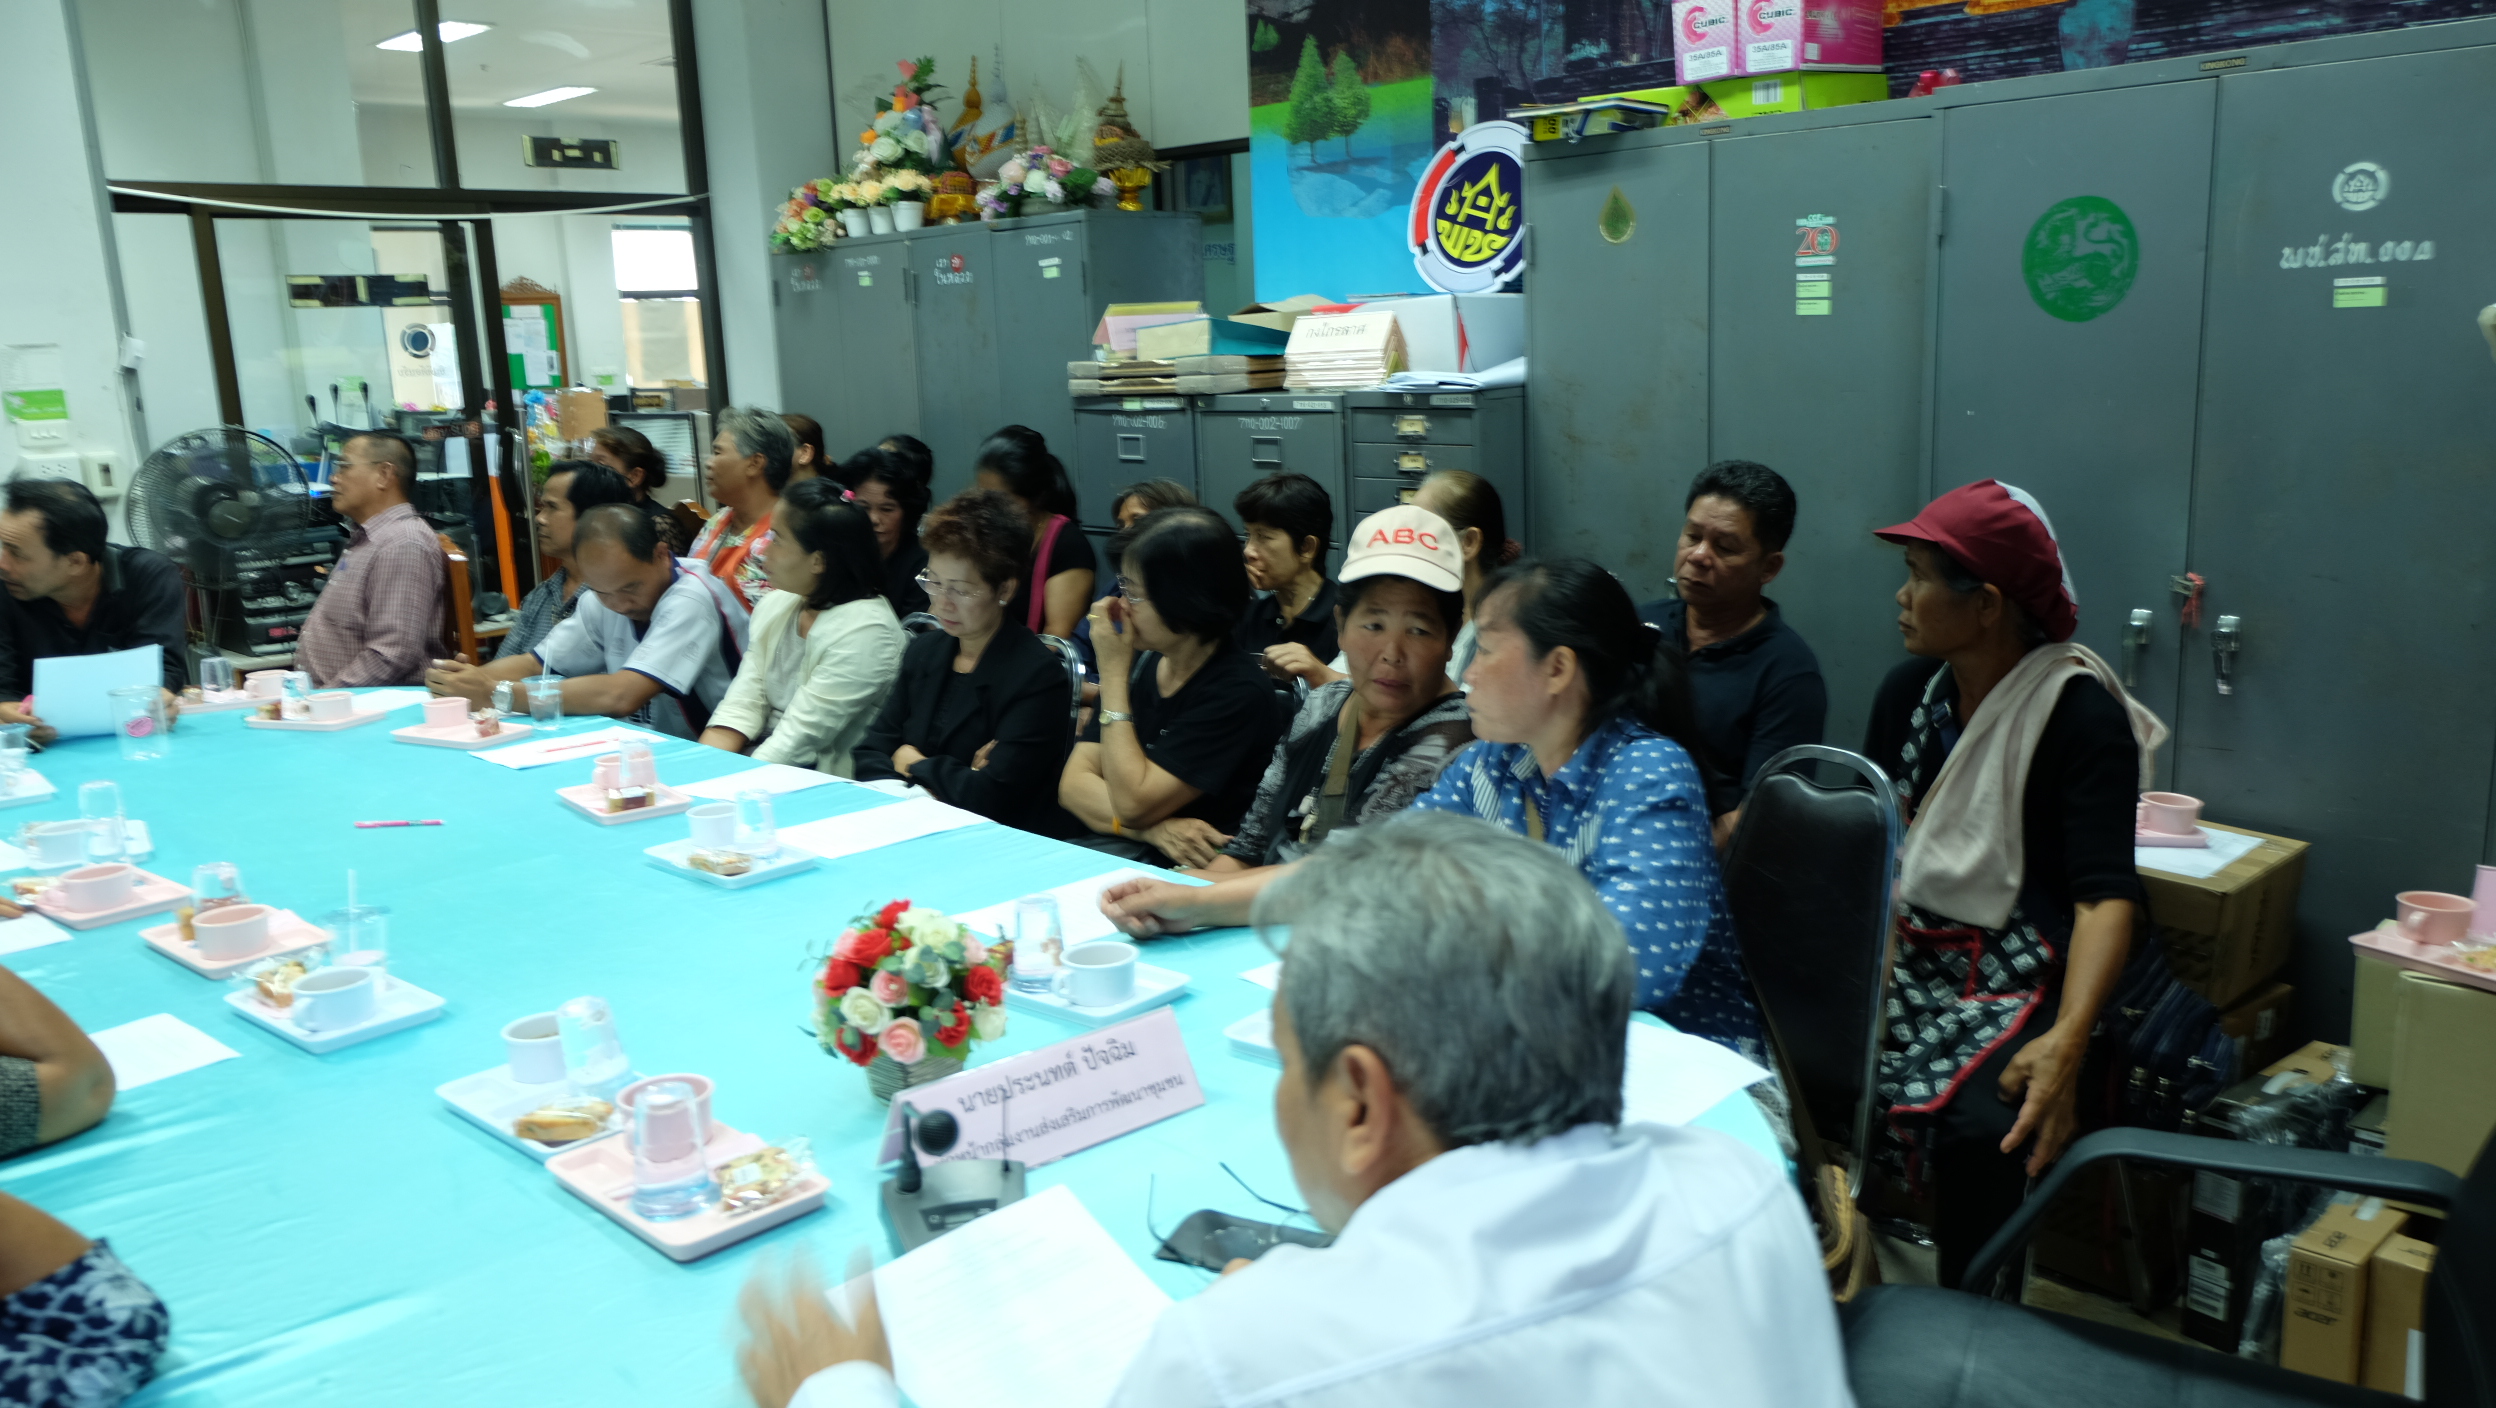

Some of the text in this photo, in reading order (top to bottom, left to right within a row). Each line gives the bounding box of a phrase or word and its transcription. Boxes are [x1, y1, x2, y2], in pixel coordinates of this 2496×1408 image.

[1758, 8, 1794, 20] CUBIC
[1693, 16, 1727, 29] CUBIC
[1366, 527, 1439, 551] ABC
